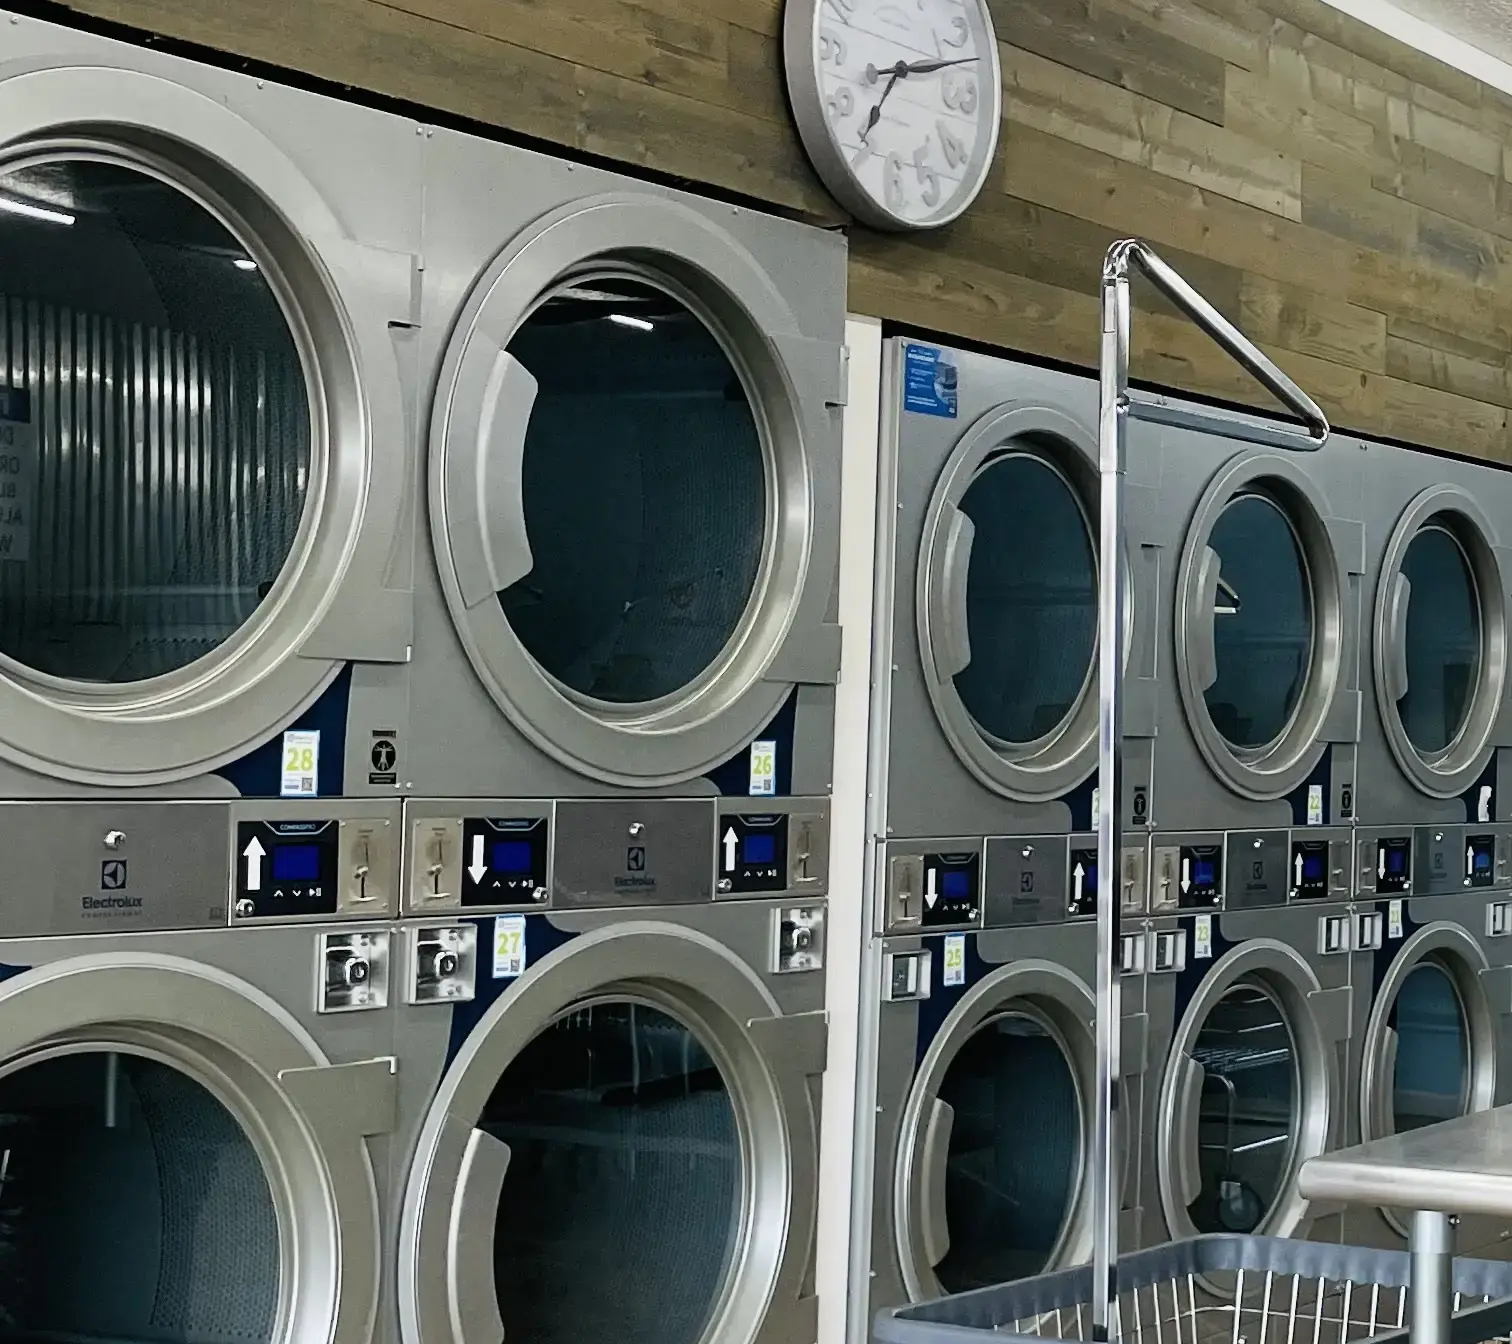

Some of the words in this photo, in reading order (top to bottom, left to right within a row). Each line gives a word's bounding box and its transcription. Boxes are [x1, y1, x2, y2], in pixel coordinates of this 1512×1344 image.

[931, 16, 969, 59] 2
[827, 86, 854, 126] 8
[941, 71, 978, 115] 3
[935, 119, 968, 169] 4
[883, 151, 904, 206] 6
[912, 134, 941, 207] 5
[286, 748, 313, 772] 28
[752, 755, 772, 775] 26
[82, 895, 143, 909] Electrolux
[497, 932, 522, 955] 27
[946, 949, 962, 967] 25
